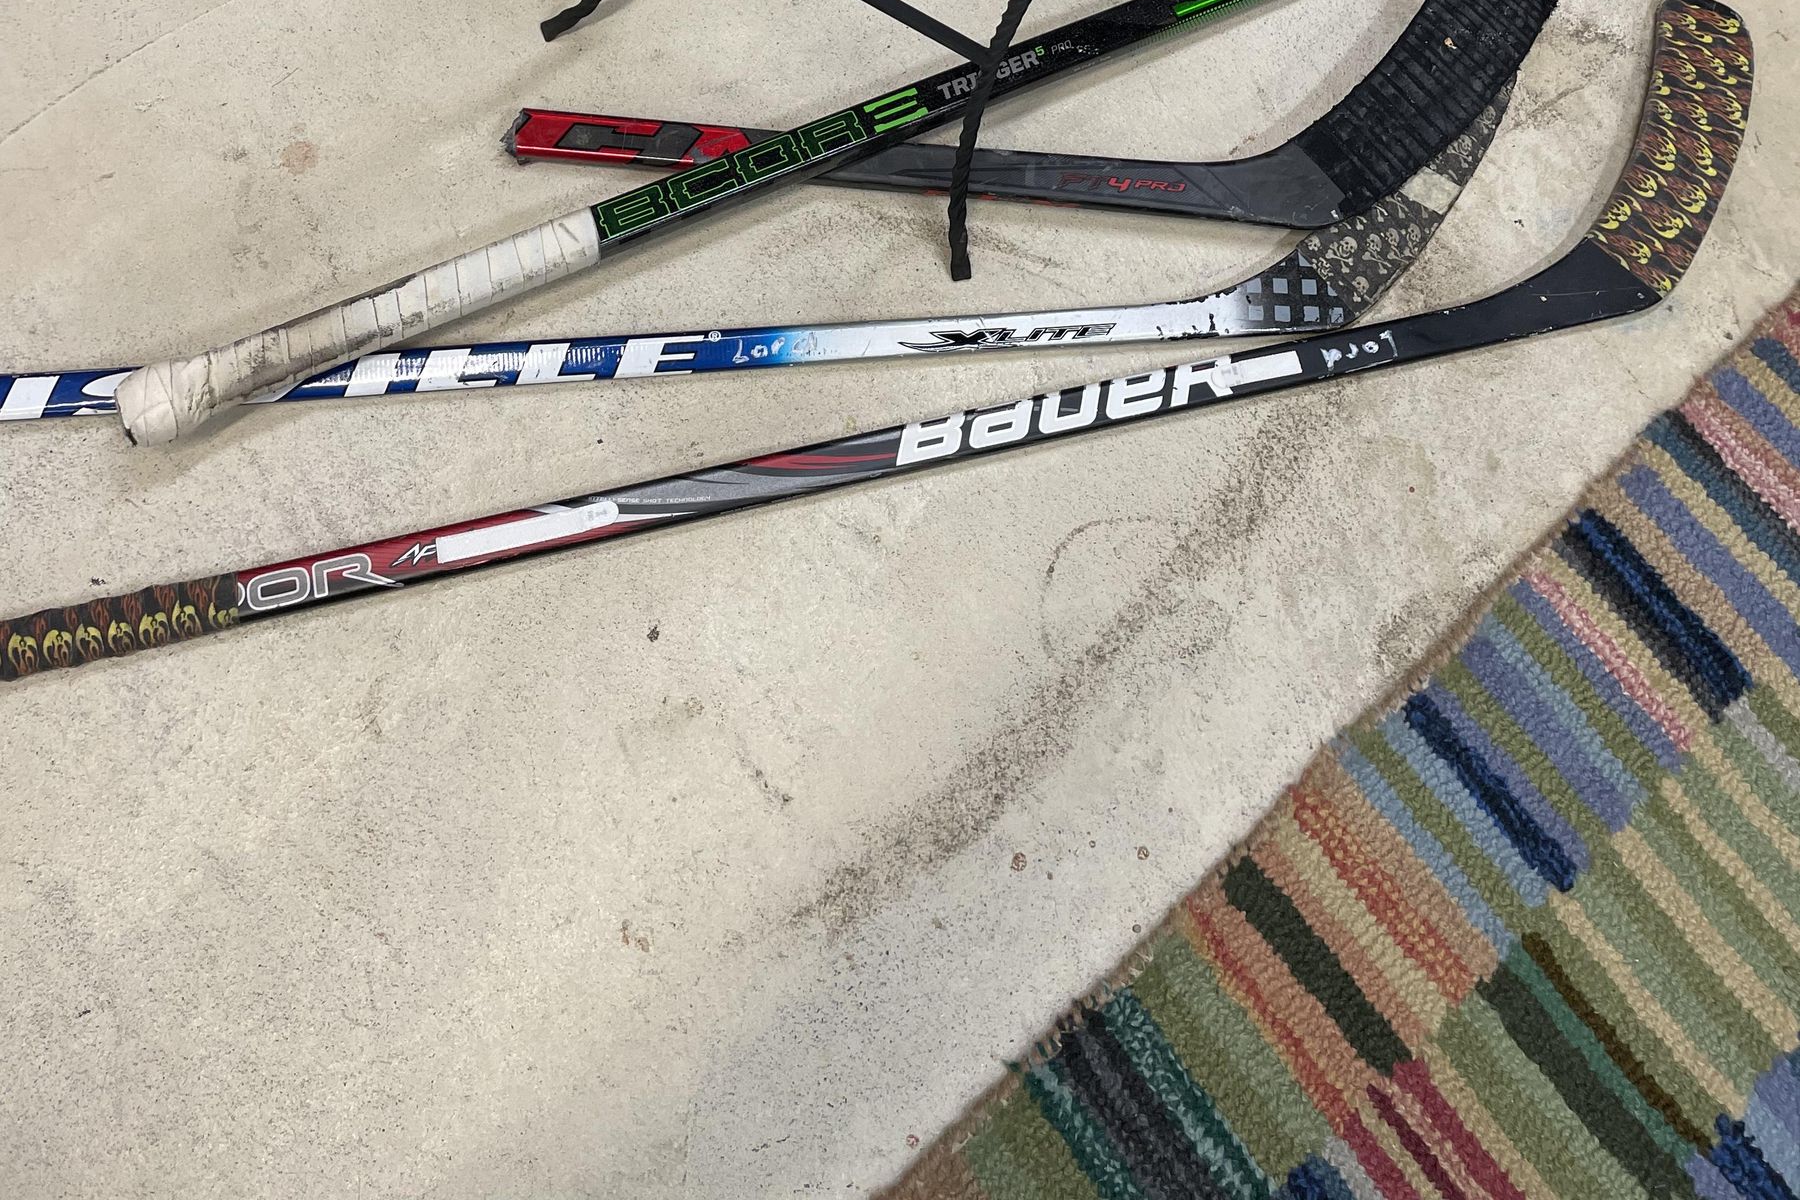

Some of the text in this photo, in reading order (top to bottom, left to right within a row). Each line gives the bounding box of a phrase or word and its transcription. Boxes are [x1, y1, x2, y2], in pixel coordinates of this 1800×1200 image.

[937, 46, 1045, 100] TRIGER5
[1051, 40, 1073, 55] PRO
[1320, 330, 1397, 371] Lord
[238, 553, 405, 611] OR
